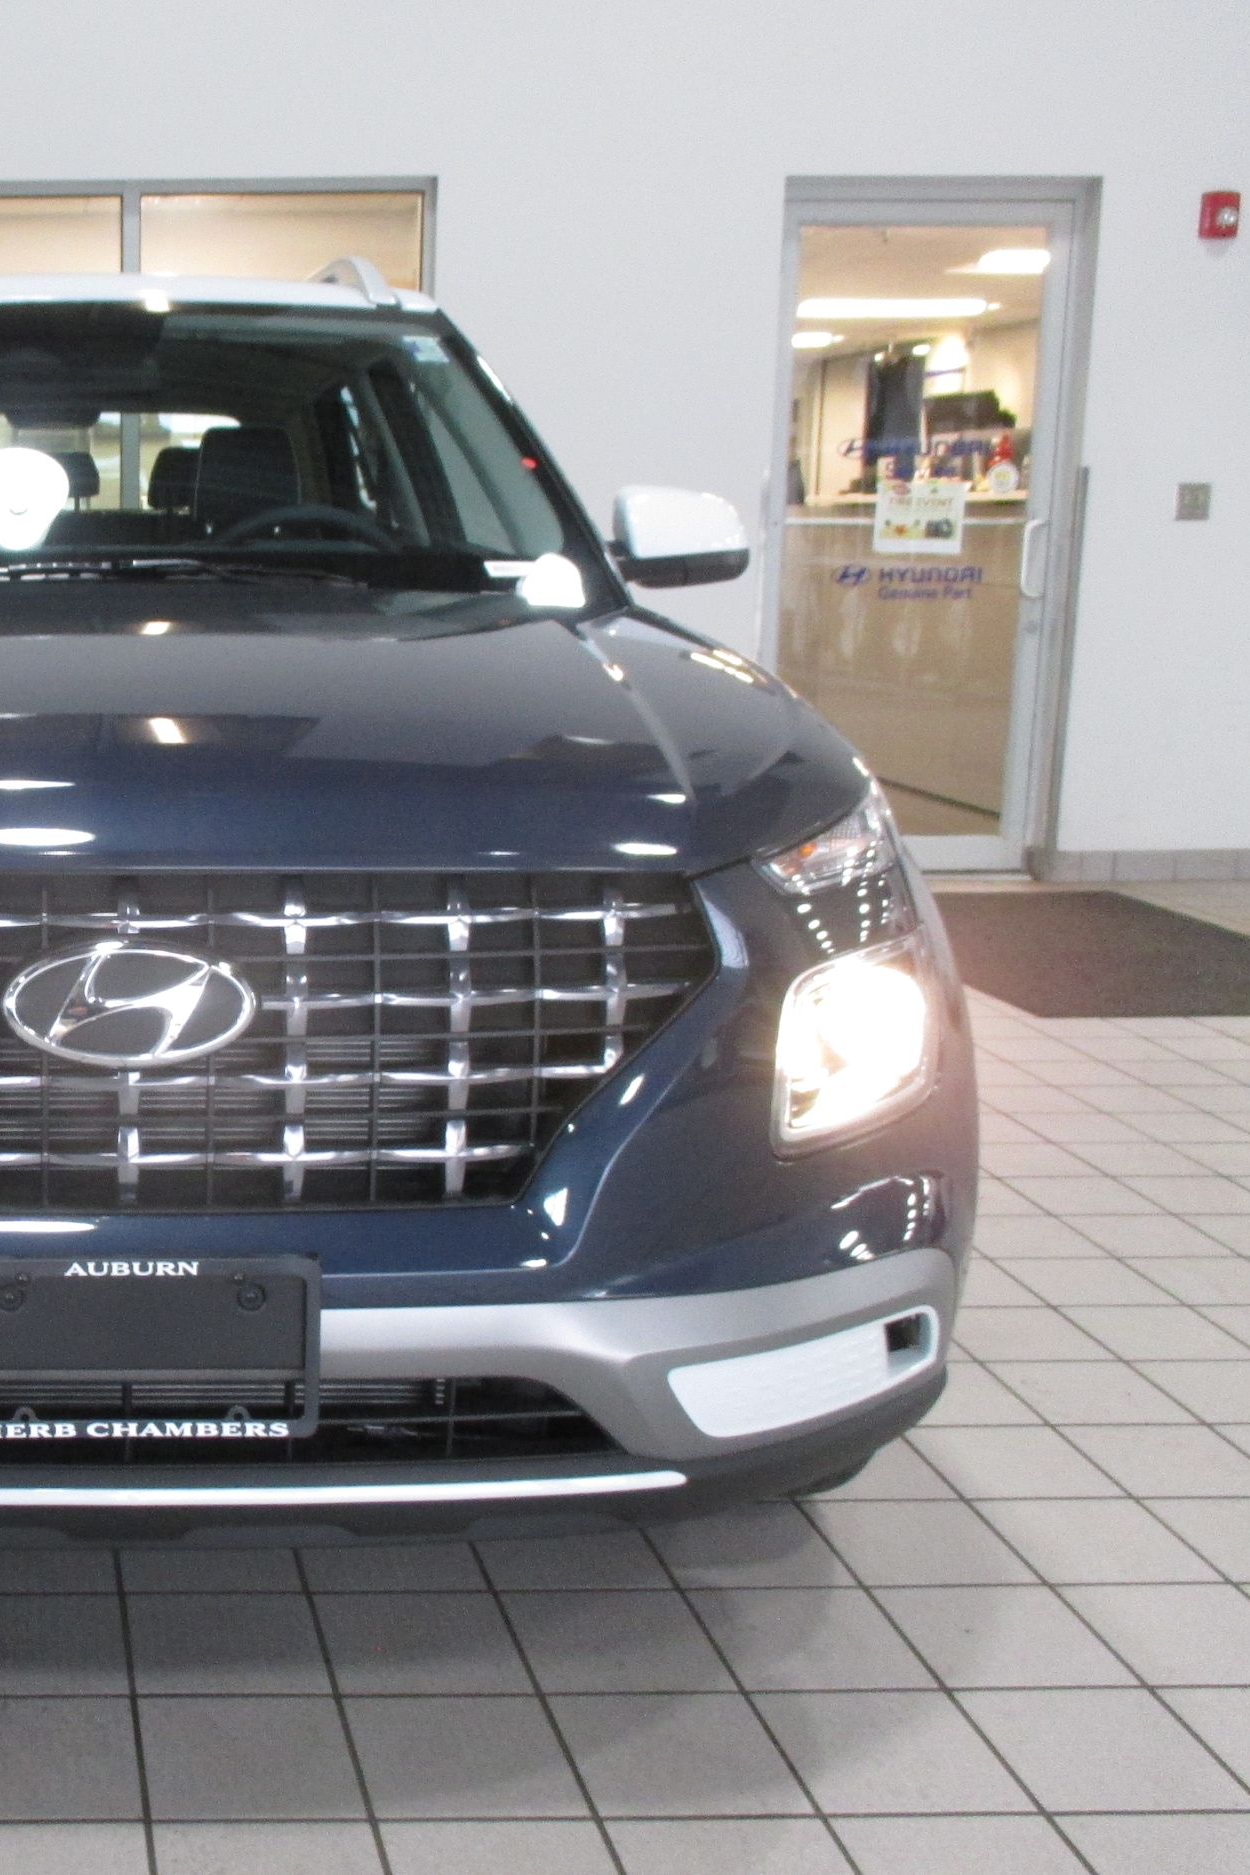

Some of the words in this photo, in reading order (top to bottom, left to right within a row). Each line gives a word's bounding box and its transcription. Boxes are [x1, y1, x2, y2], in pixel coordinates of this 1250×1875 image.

[878, 566, 983, 583] HYUNDAI
[63, 1260, 200, 1278] AUBURN
[85, 1421, 290, 1439] CHAMBERS
